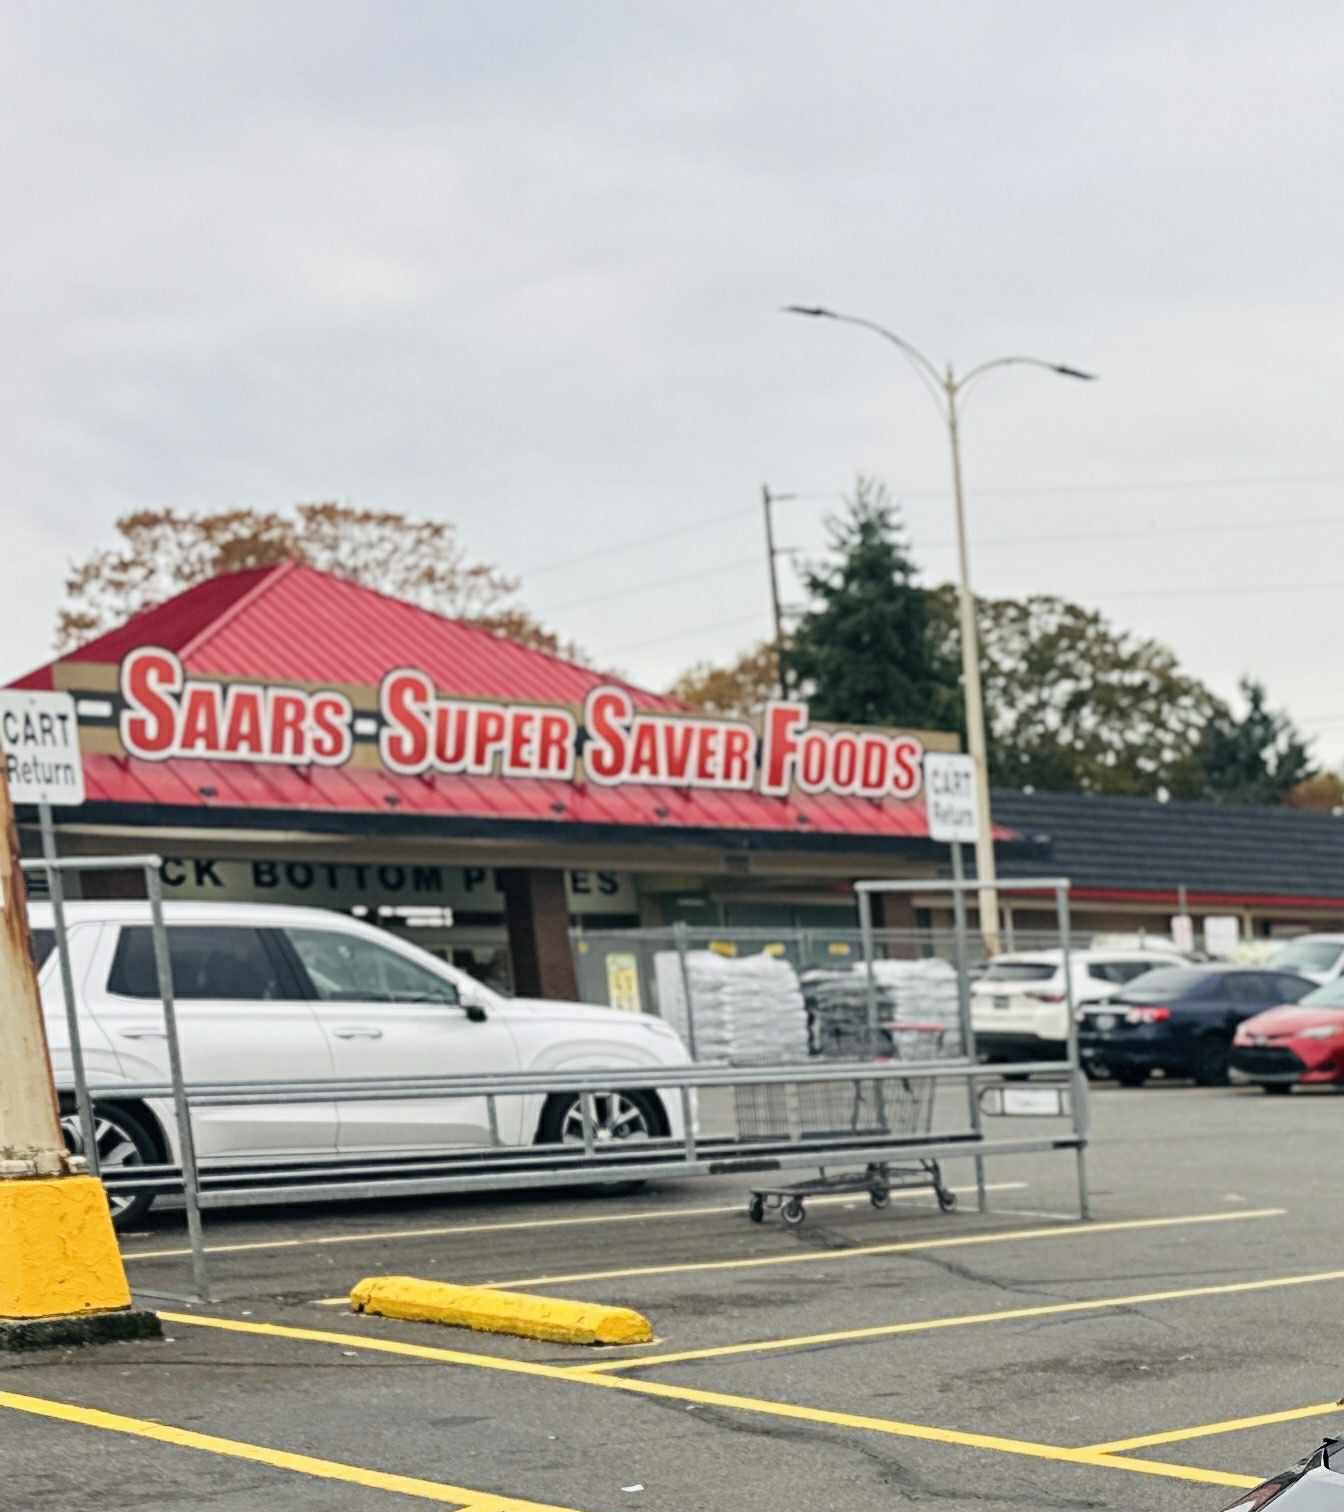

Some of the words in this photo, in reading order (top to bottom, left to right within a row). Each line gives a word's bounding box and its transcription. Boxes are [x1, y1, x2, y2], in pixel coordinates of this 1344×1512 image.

[3, 710, 69, 747] CART
[125, 650, 348, 762] SAARS
[384, 673, 571, 774] SUPER
[588, 690, 753, 784] SAVER
[765, 706, 918, 793] FOODS
[5, 752, 77, 786] Return
[158, 857, 224, 888] CK
[252, 859, 444, 893] BOTTOM
[463, 867, 619, 895] PES
